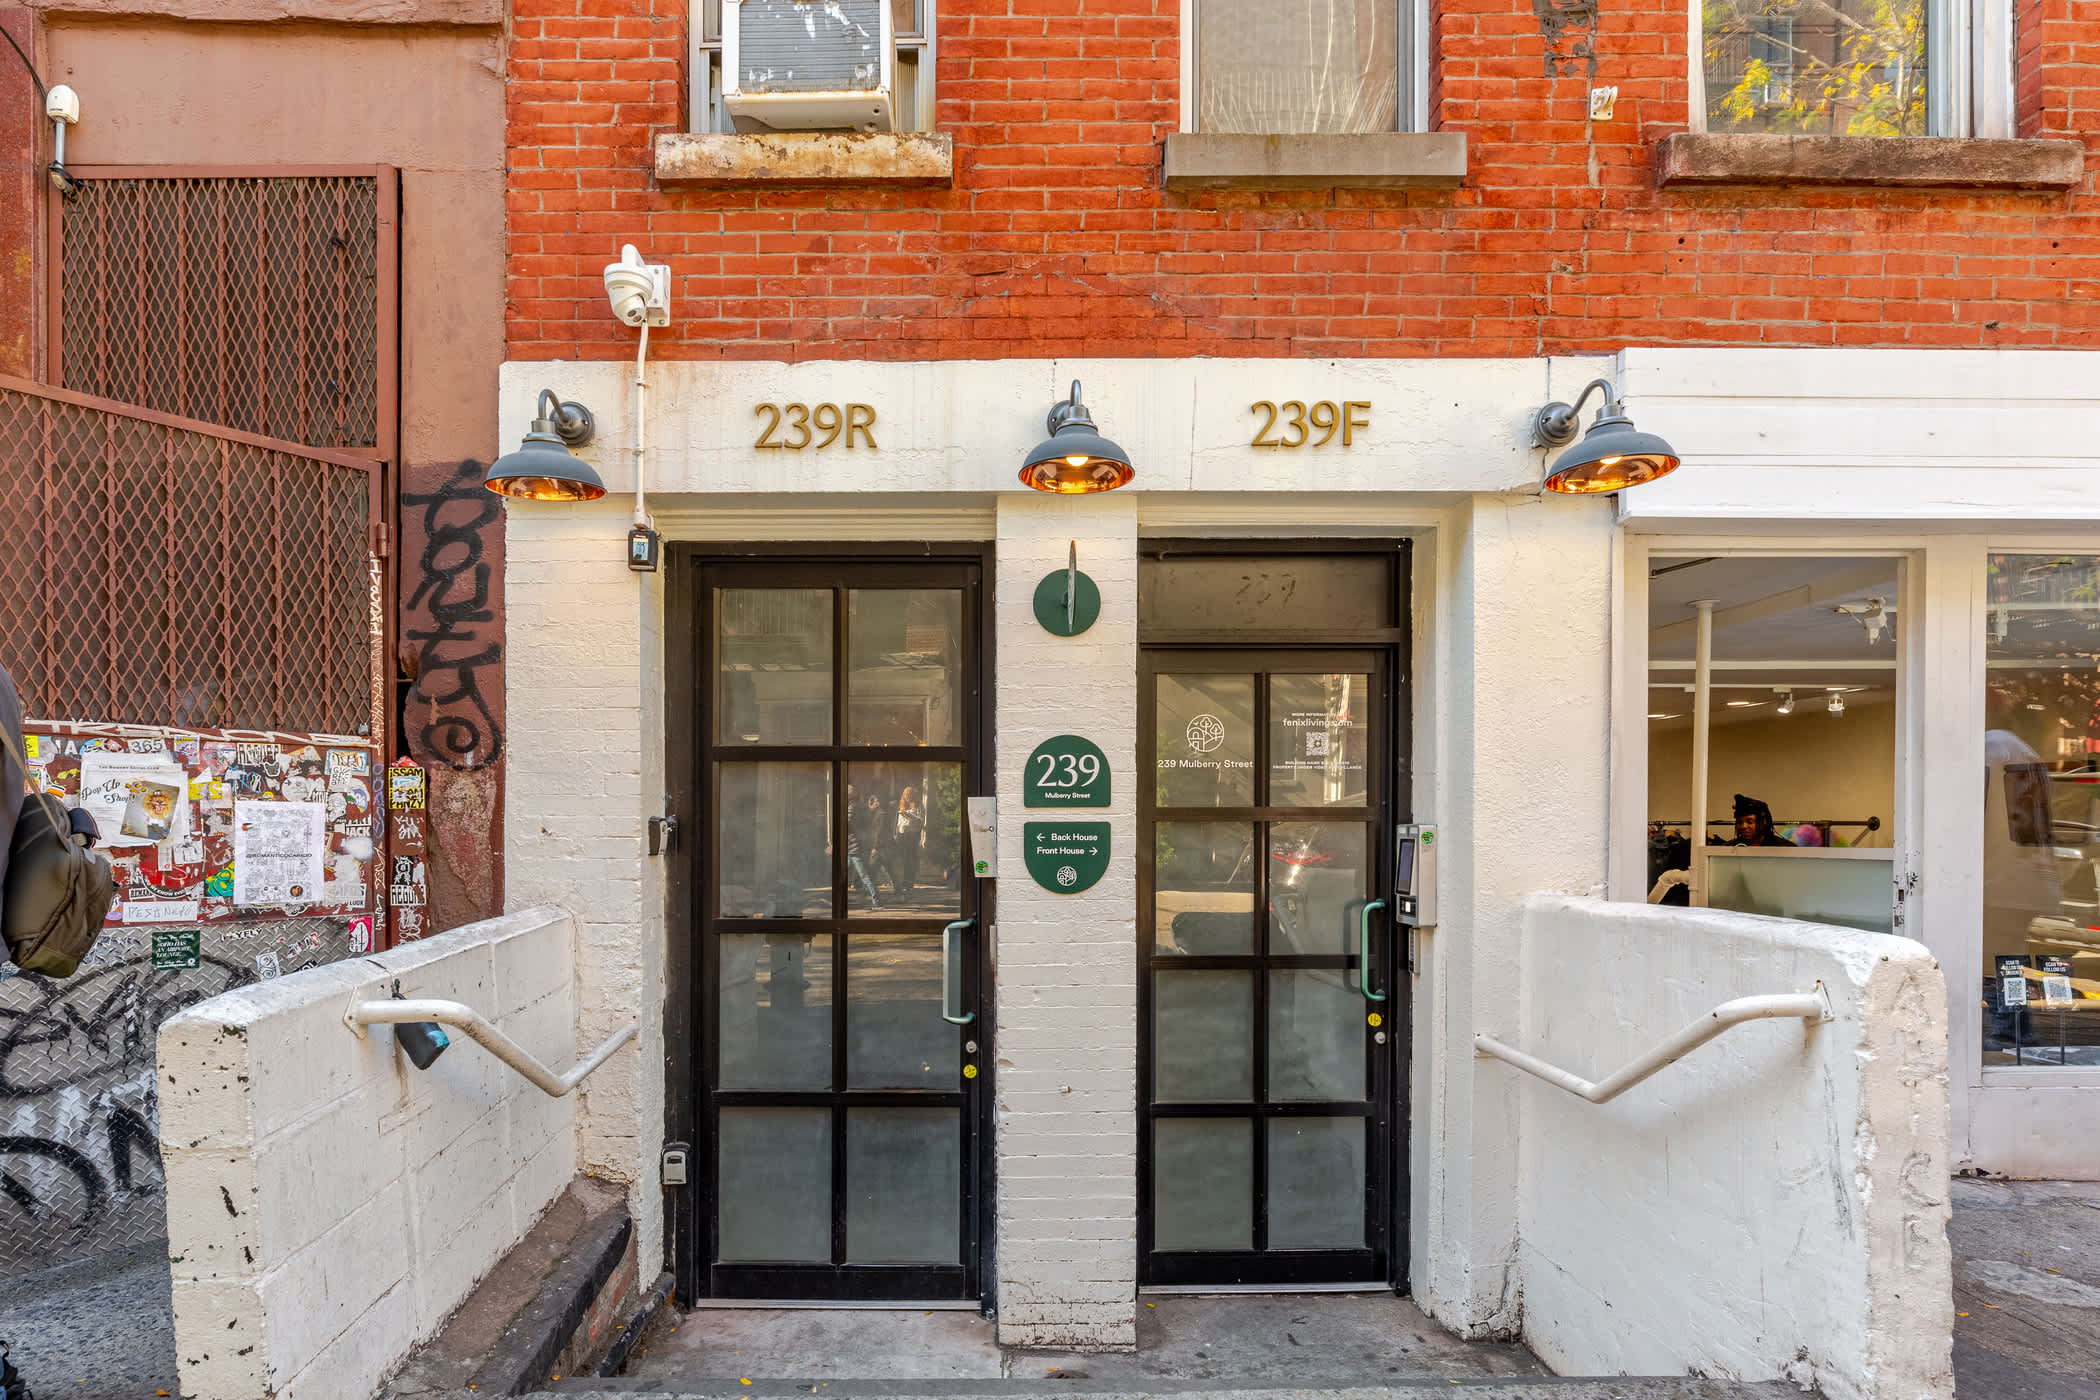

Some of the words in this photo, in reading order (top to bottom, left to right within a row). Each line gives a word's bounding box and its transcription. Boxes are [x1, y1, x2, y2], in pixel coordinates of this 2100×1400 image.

[754, 402, 877, 449] 239R
[1251, 400, 1371, 447] 239F
[1283, 718, 1353, 728] fenixliving.com
[130, 739, 164, 752] 365
[1037, 754, 1100, 787] 239
[1158, 760, 1176, 768] 239
[1179, 760, 1221, 769] Mulberry
[1224, 760, 1254, 768] Street
[81, 786, 102, 801] Pop
[103, 778, 121, 793] Up
[1051, 833, 1071, 841] Back
[1073, 833, 1098, 841] House
[1037, 847, 1057, 855] Front
[1059, 847, 1085, 855] House
